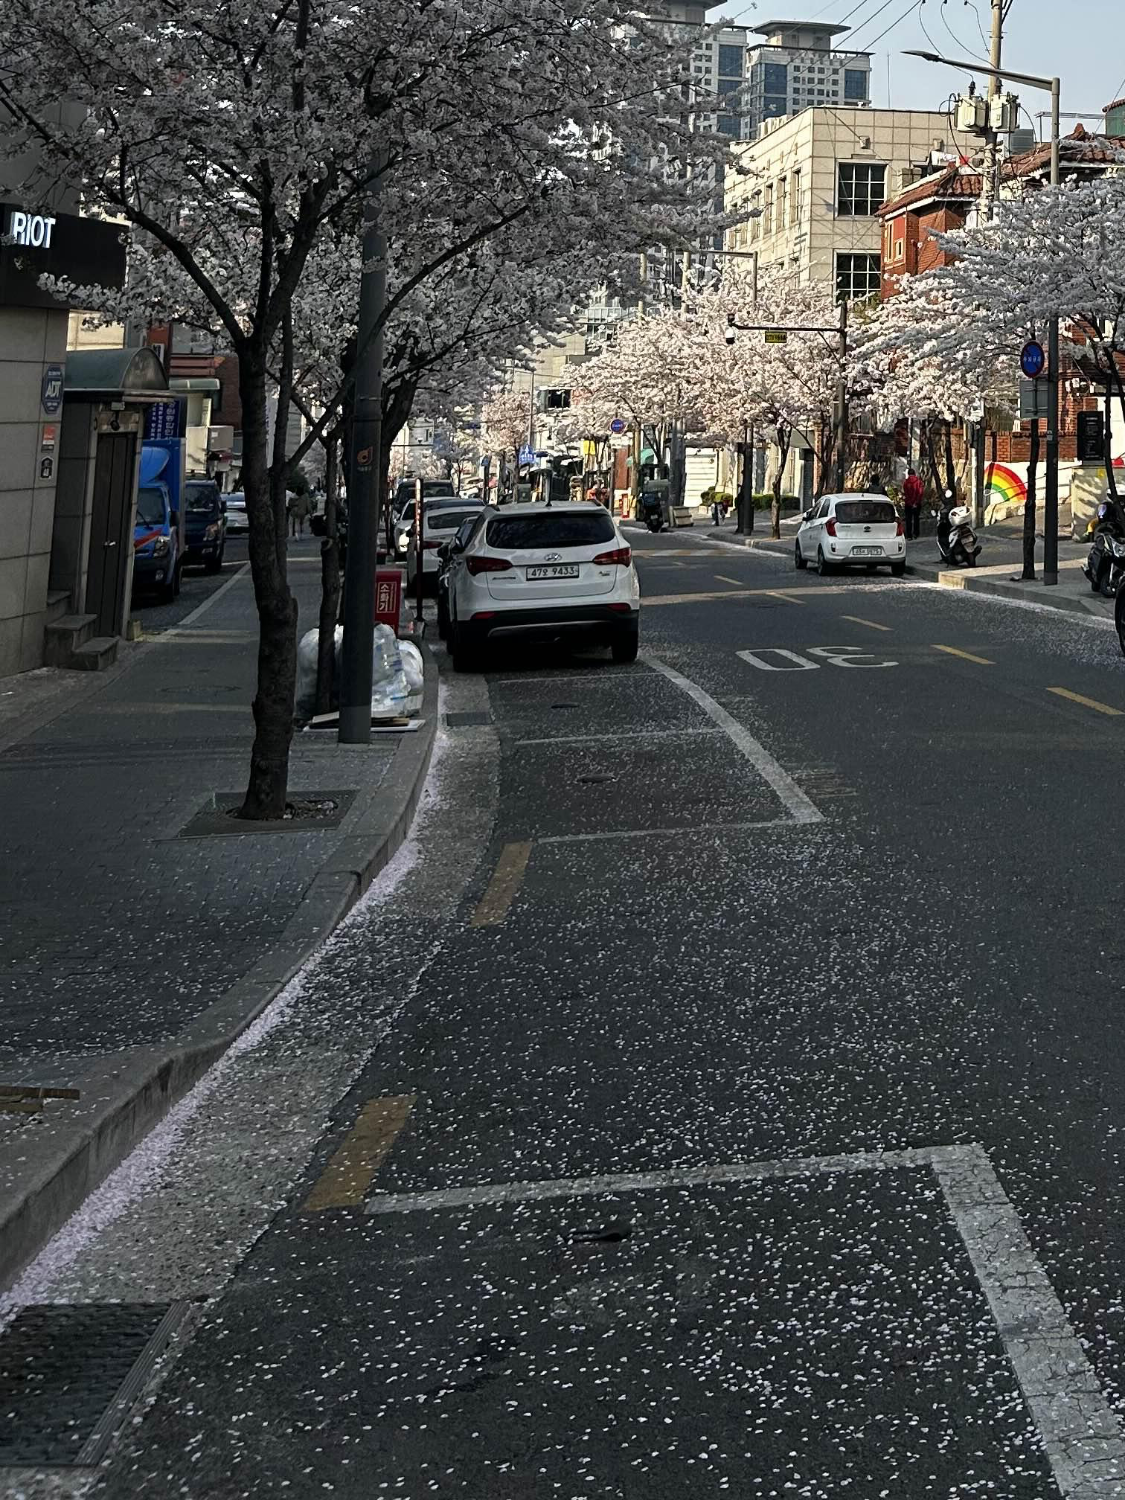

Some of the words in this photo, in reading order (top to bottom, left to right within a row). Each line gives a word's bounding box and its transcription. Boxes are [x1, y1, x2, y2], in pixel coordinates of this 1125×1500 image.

[11, 211, 56, 249] RIOT
[45, 381, 62, 398] ADT
[552, 566, 575, 576] 9433
[379, 583, 390, 613] 소화기
[735, 646, 899, 671] 30
